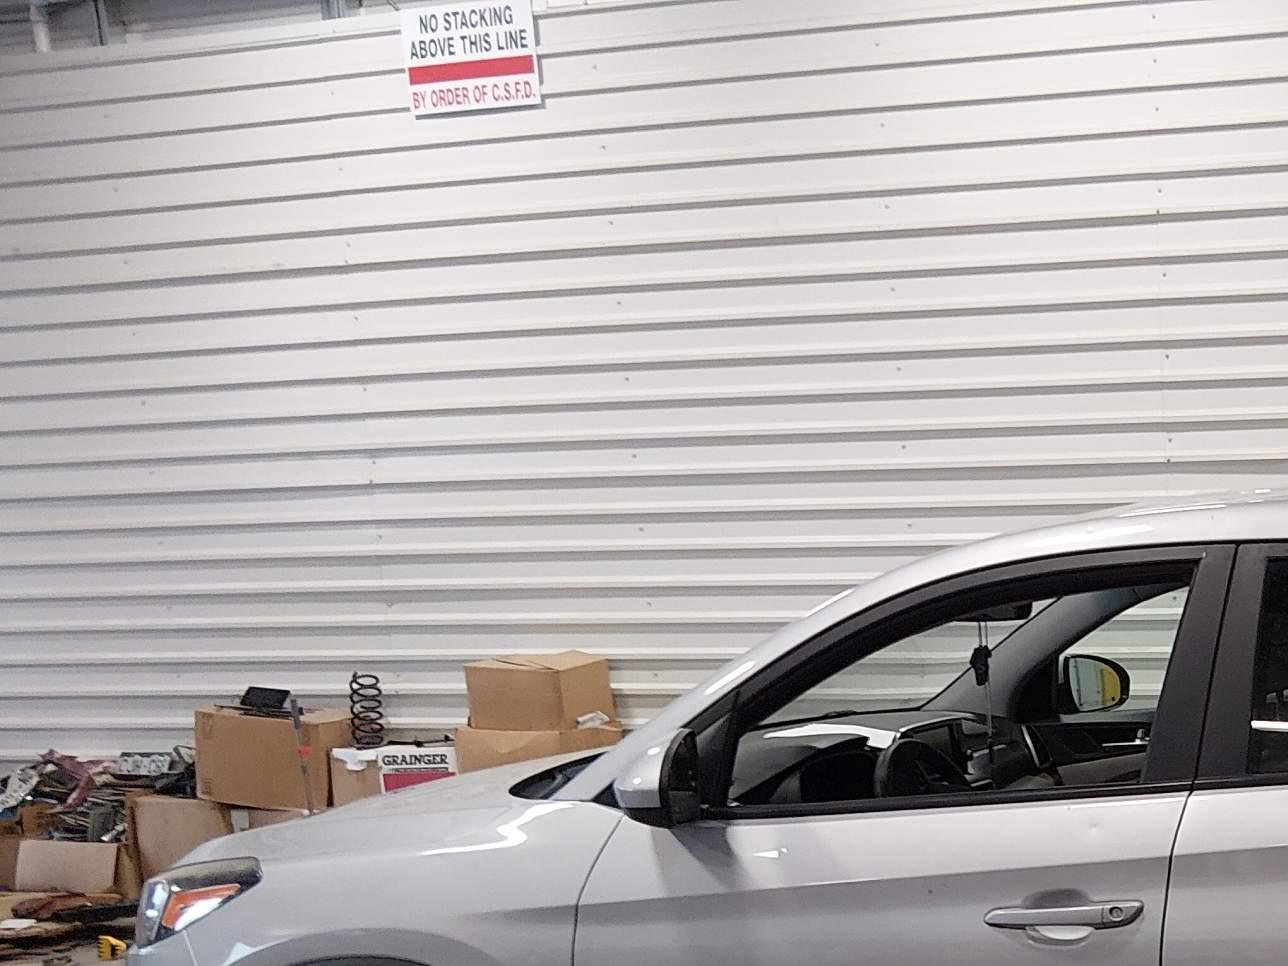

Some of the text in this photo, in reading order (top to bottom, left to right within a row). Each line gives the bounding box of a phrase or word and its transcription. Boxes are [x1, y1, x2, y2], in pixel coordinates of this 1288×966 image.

[419, 5, 513, 34] NO STACKING
[410, 29, 528, 60] ABOVE THIS LINE
[412, 80, 537, 110] BY ORDER OF C.S.F.D.
[382, 753, 448, 766] GRAINGER
